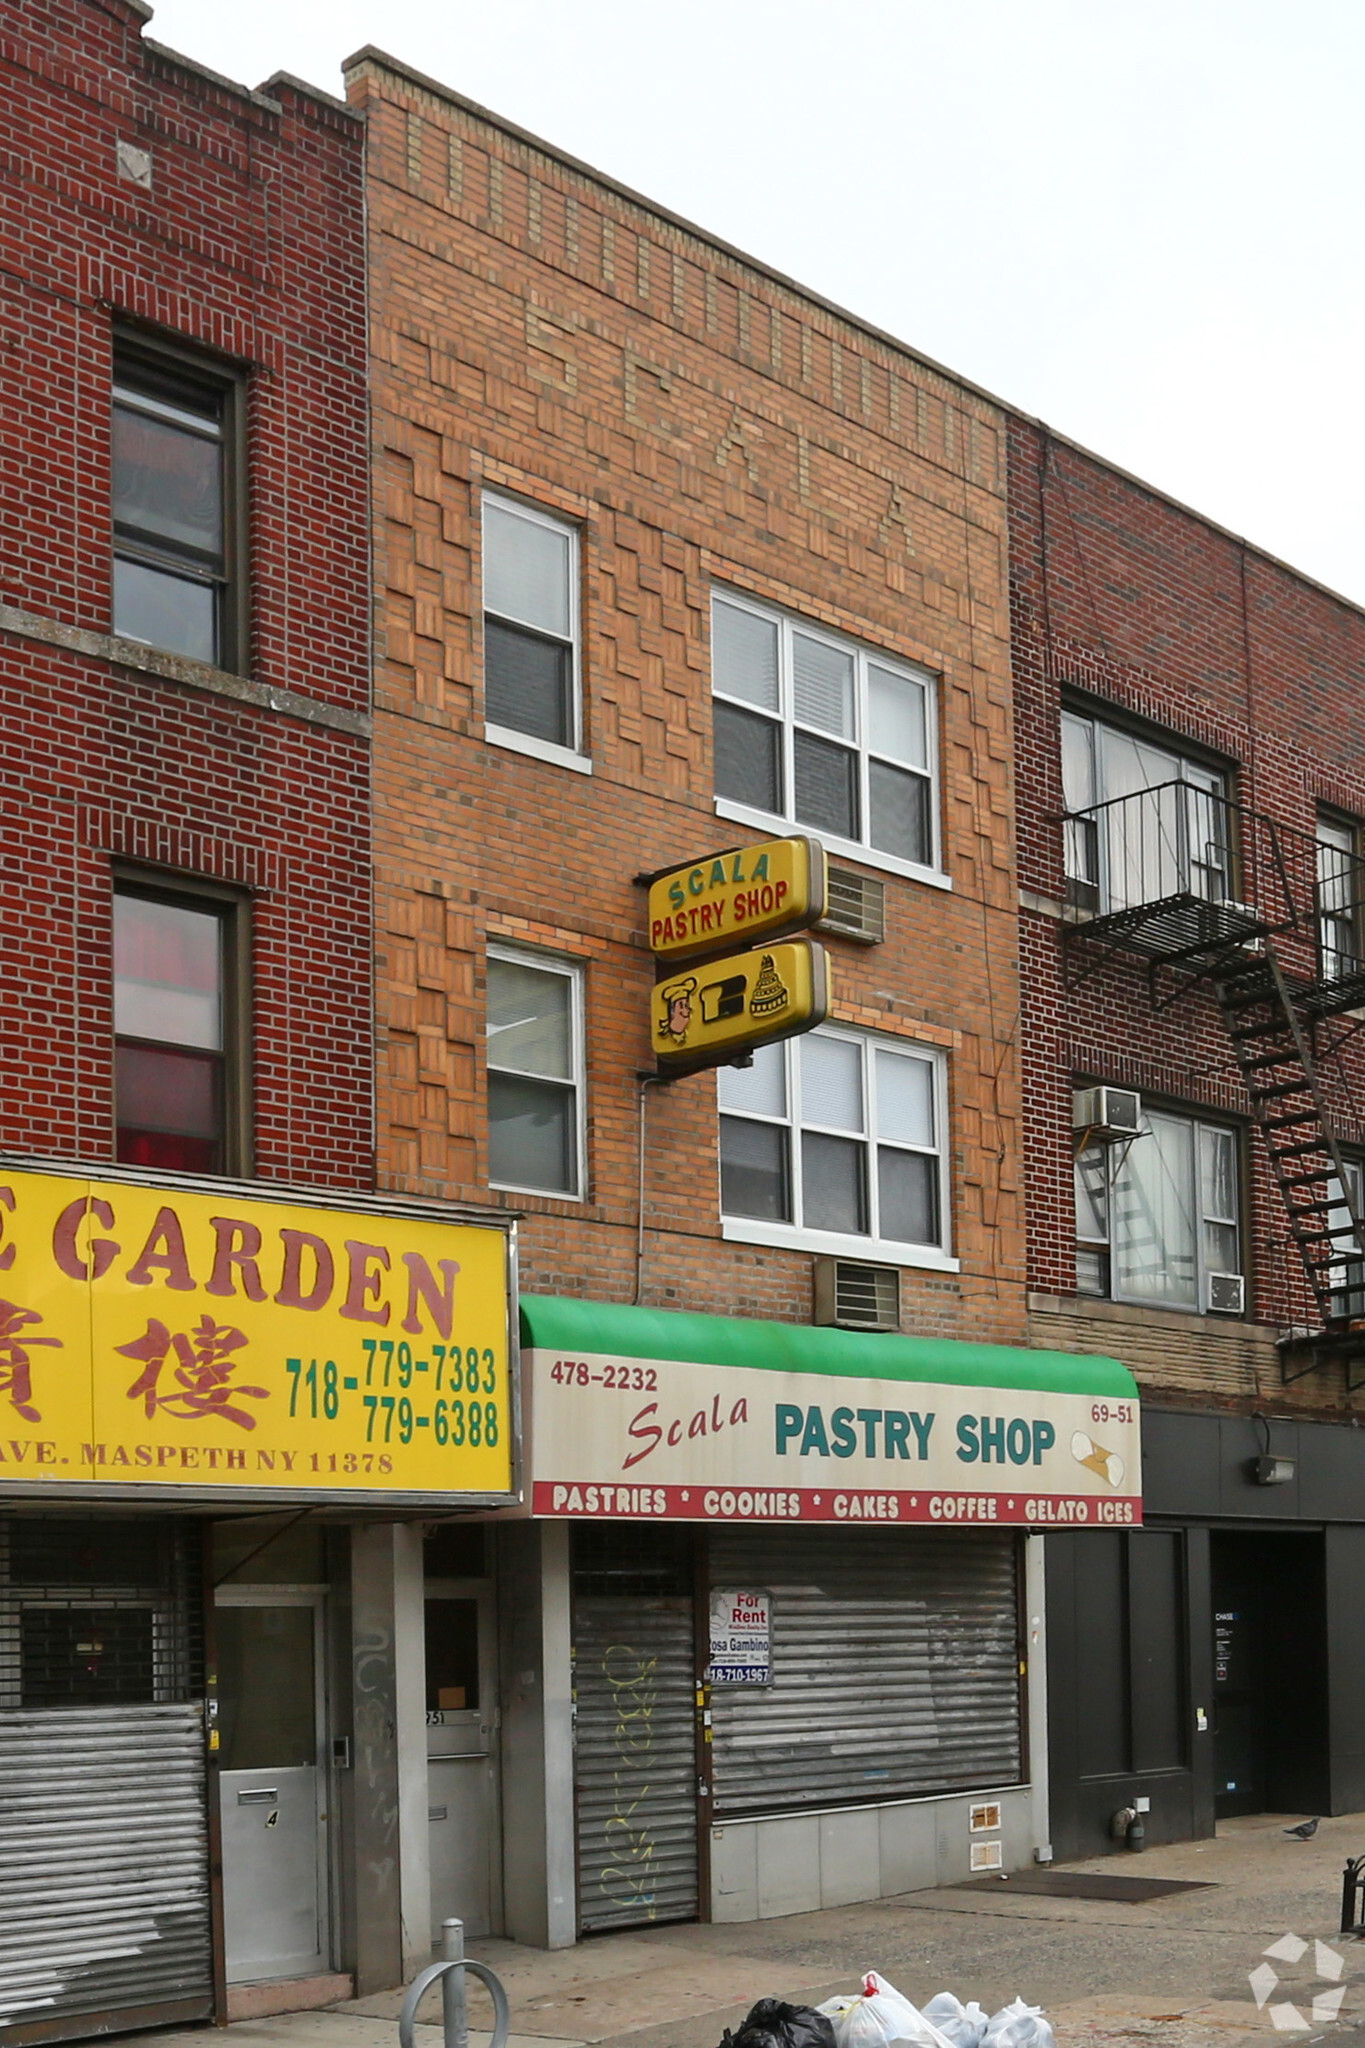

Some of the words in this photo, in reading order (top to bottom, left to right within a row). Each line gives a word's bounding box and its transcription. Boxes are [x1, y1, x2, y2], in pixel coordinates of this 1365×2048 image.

[668, 853, 770, 910] SCALA
[652, 899, 726, 946] PASTRY
[733, 880, 788, 922] SHOP
[52, 1195, 461, 1341] GARDEN
[362, 1338, 497, 1395] 779-7383
[550, 1360, 658, 1392] 478-2232
[363, 1395, 499, 1448] 779-6388
[621, 1393, 749, 1471] Scala
[775, 1403, 936, 1461] PASTRY
[956, 1413, 1056, 1466] SHOP
[1091, 1404, 1134, 1424] 69-51
[80, 1443, 248, 1470] MASPETH
[257, 1449, 298, 1472] NY
[309, 1452, 394, 1475] 11378
[552, 1485, 667, 1515] PASTRIES
[703, 1490, 801, 1518] COOKIES
[833, 1494, 899, 1519] CAKES
[928, 1496, 998, 1520] COFFEE
[1024, 1499, 1088, 1522] GELATO
[1097, 1501, 1134, 1523] ICES
[732, 1608, 766, 1623] Rent
[737, 1592, 760, 1607] For
[711, 1640, 728, 1651] osa
[729, 1637, 769, 1651] Gambino
